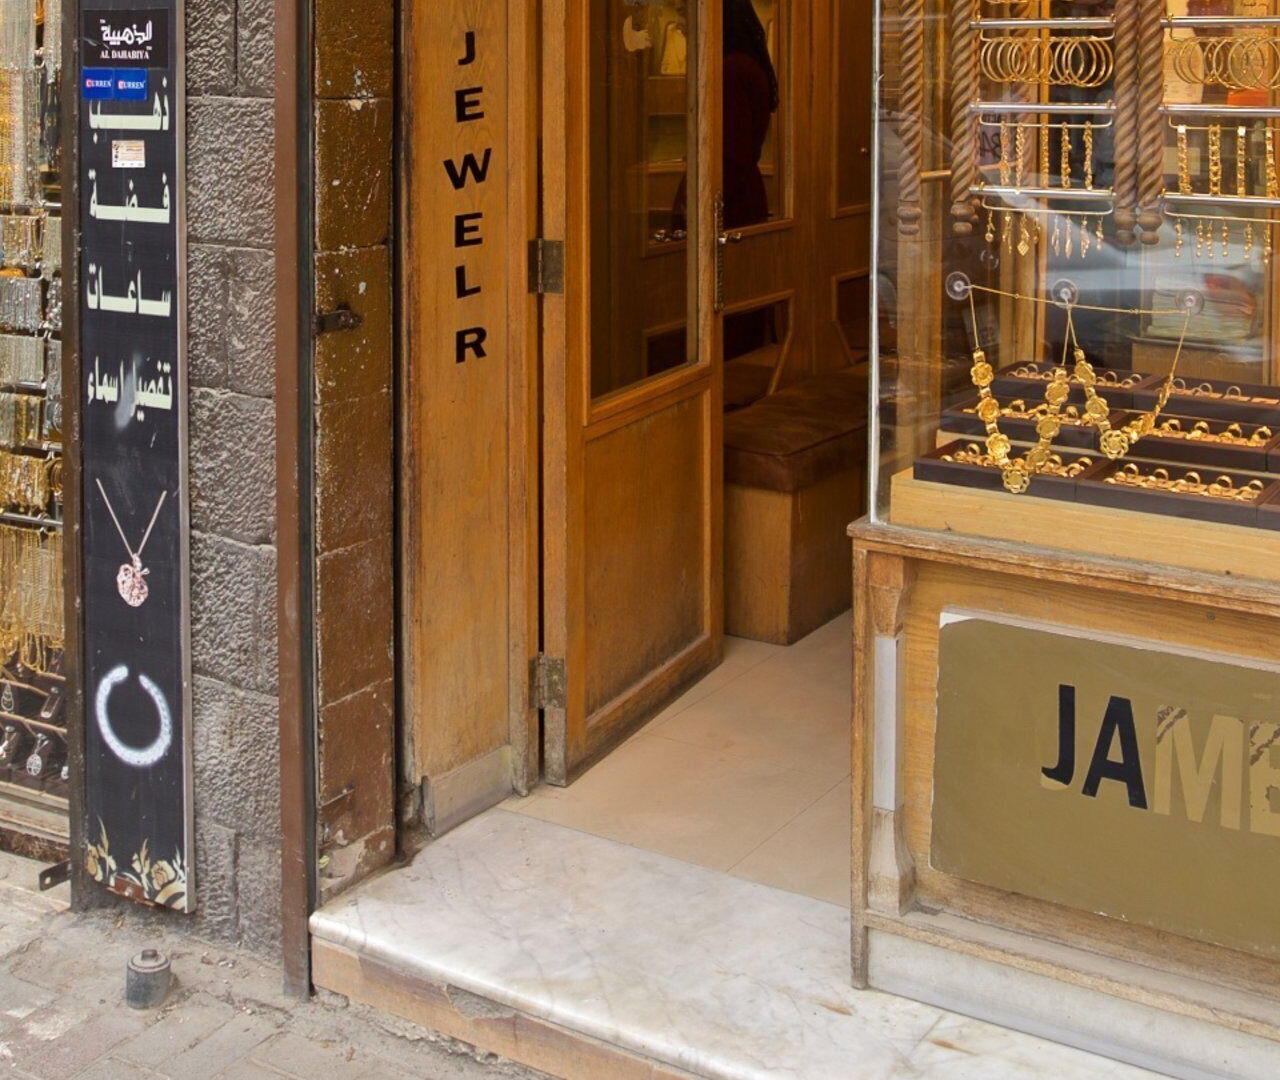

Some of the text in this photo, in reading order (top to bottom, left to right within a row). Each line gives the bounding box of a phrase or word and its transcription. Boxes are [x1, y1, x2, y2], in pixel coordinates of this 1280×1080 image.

[100, 19, 153, 46] الذهبية
[100, 49, 150, 60] AL DAHABIYA
[86, 79, 112, 88] CURREN
[88, 77, 169, 144] ذهب
[89, 169, 170, 224] فضة
[443, 30, 492, 364] JEWELR
[87, 263, 171, 317] ساعات
